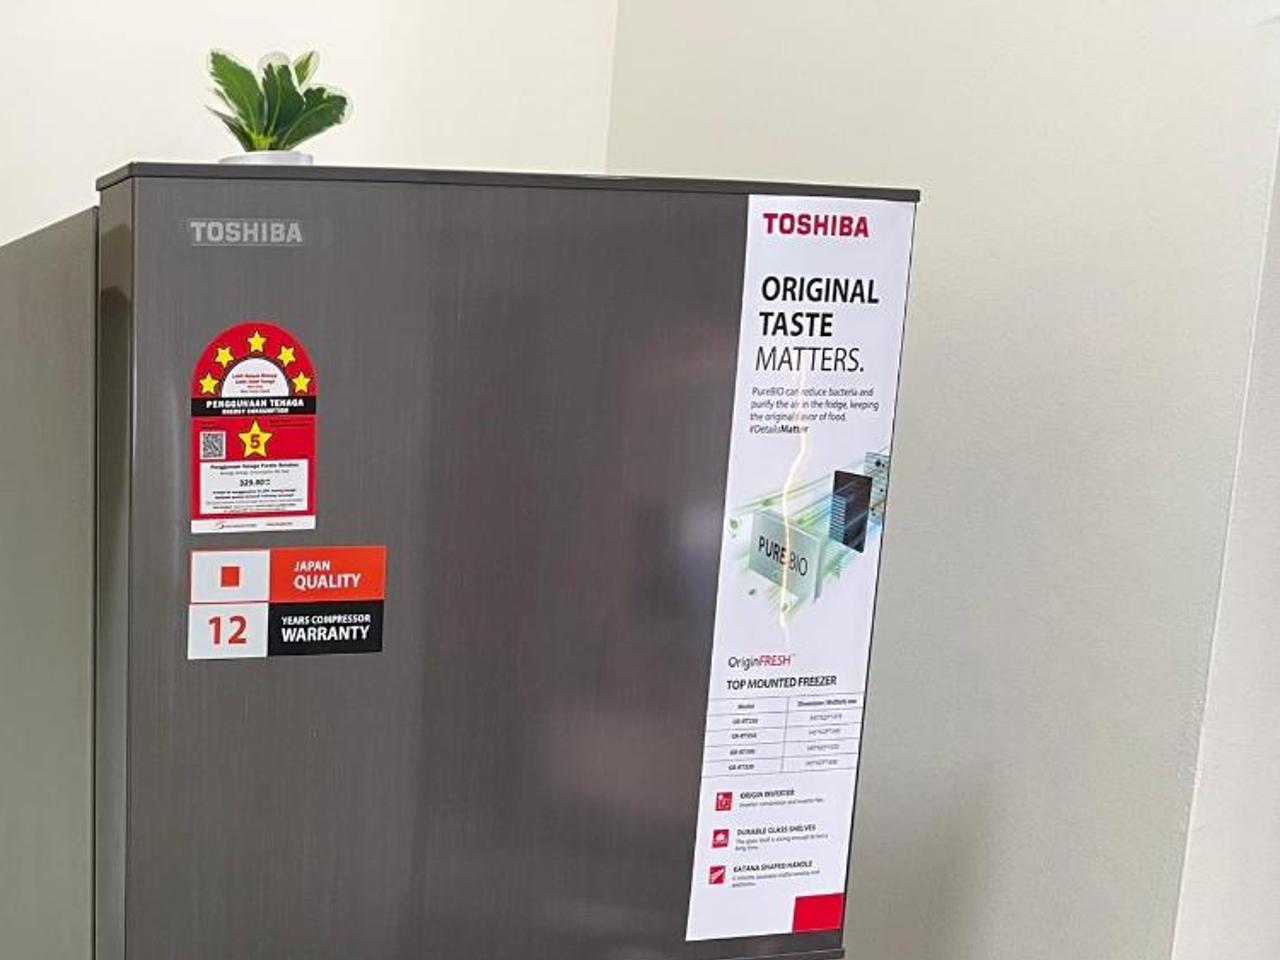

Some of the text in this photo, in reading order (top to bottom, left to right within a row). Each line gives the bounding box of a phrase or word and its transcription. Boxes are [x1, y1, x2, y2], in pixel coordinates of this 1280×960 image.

[190, 221, 303, 242] TOSHIBA
[763, 212, 870, 238] TOSHIBA
[762, 276, 880, 304] ORIGINAL
[759, 312, 834, 337] TASTE
[755, 346, 865, 373] MATTERS.
[752, 387, 784, 397] PureBIO
[828, 387, 858, 397] bacteria
[860, 387, 874, 396] and
[206, 399, 304, 409] PENGGUNAAN TENAGA
[776, 400, 789, 409] the
[811, 400, 824, 409] the
[850, 401, 880, 412] keeping
[750, 413, 763, 421] the
[819, 412, 828, 421] of
[250, 434, 260, 450] 5
[758, 536, 808, 576] PURE BIO
[295, 561, 331, 572] JAPAN
[294, 574, 362, 591] QUALITY
[281, 614, 371, 626] YEARS COMPRESSOR
[209, 615, 247, 644] 12
[282, 626, 371, 642] WARRANTY
[728, 655, 791, 671] OriginFRESH
[727, 675, 837, 690] TOP MOUNTED FREEZER
[789, 824, 816, 832] SHELVES
[733, 860, 813, 872] KATANA SHAPED HANDLE
